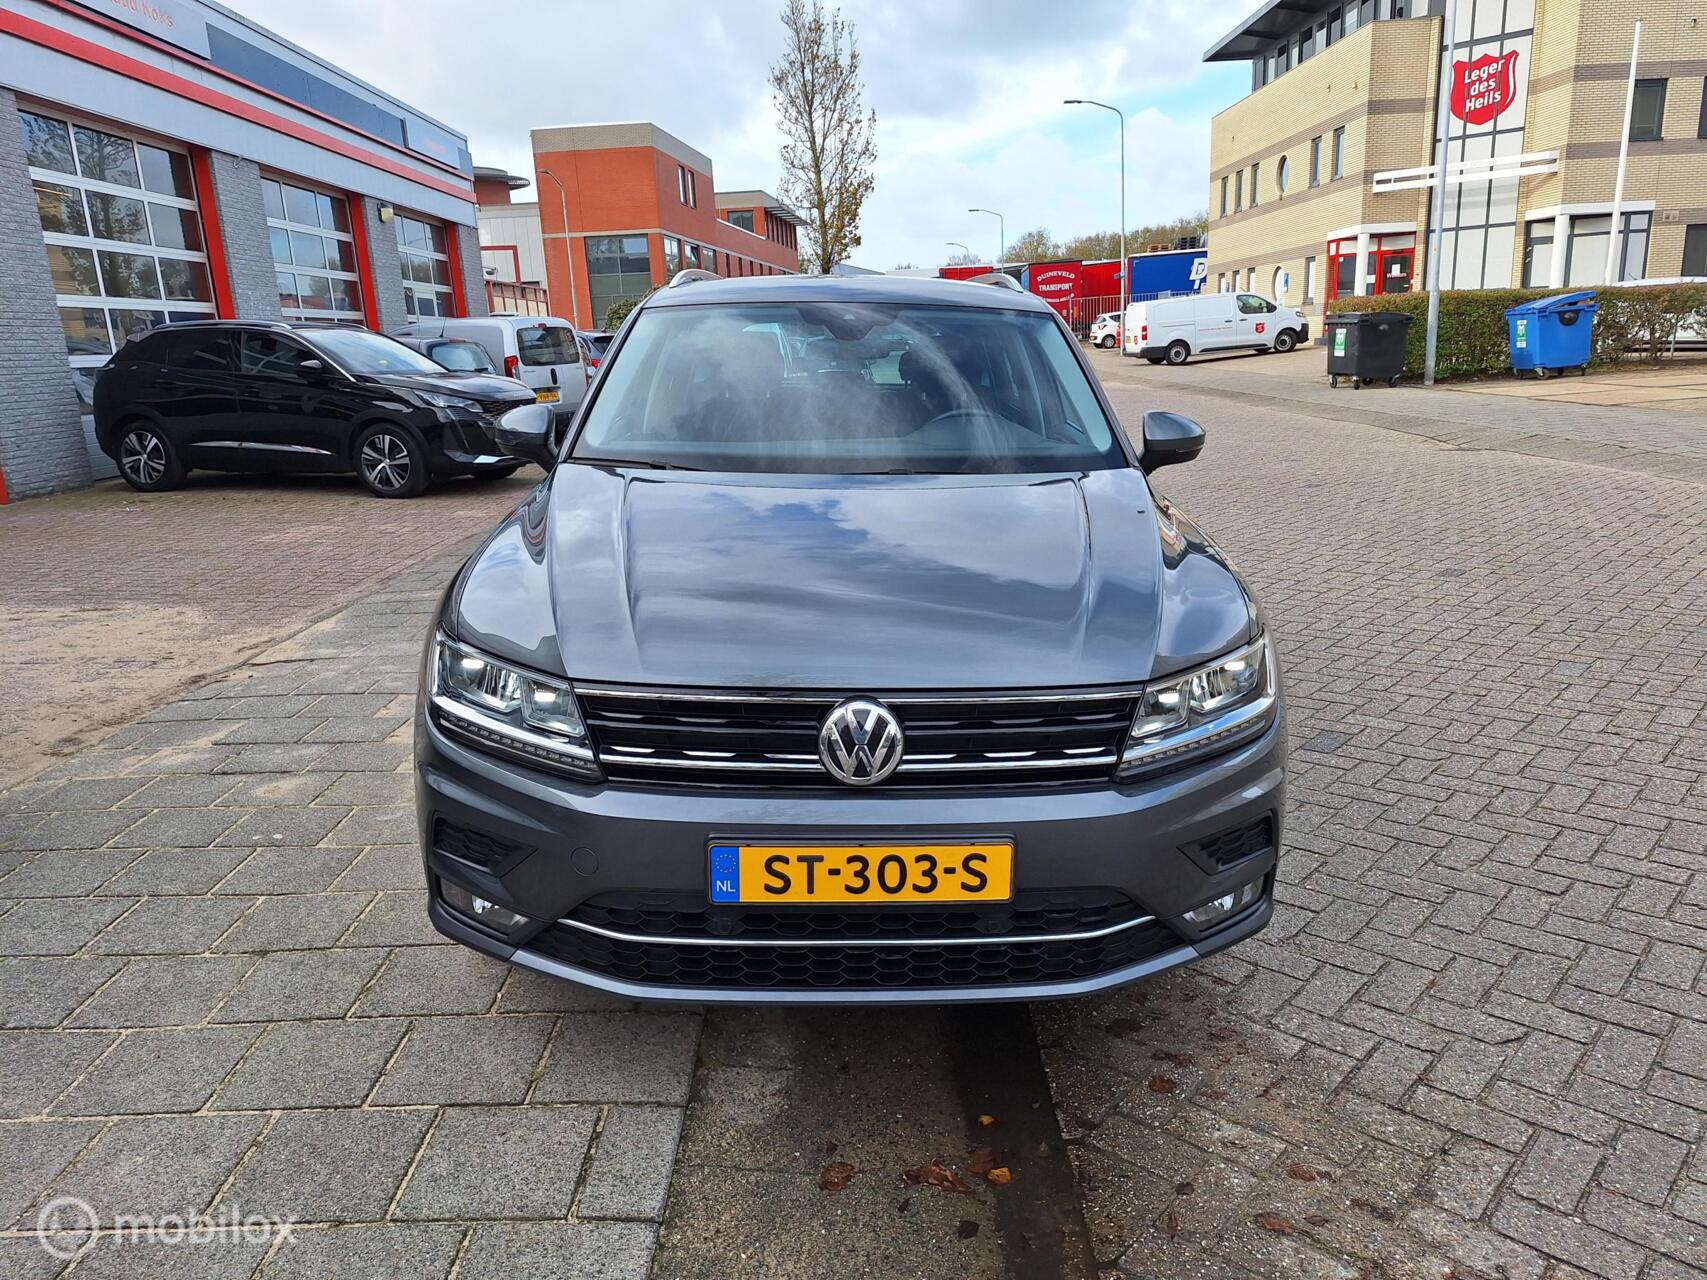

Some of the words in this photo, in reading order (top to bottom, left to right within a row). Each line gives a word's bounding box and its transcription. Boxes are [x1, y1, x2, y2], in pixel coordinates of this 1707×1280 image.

[1464, 59, 1506, 84] Leger
[1470, 78, 1496, 96] des
[1465, 90, 1502, 113] Heils
[1036, 270, 1076, 282] DUINEVELD
[1039, 282, 1073, 292] TRANSPORT
[763, 853, 988, 895] ST-303-S
[716, 880, 736, 892] NL
